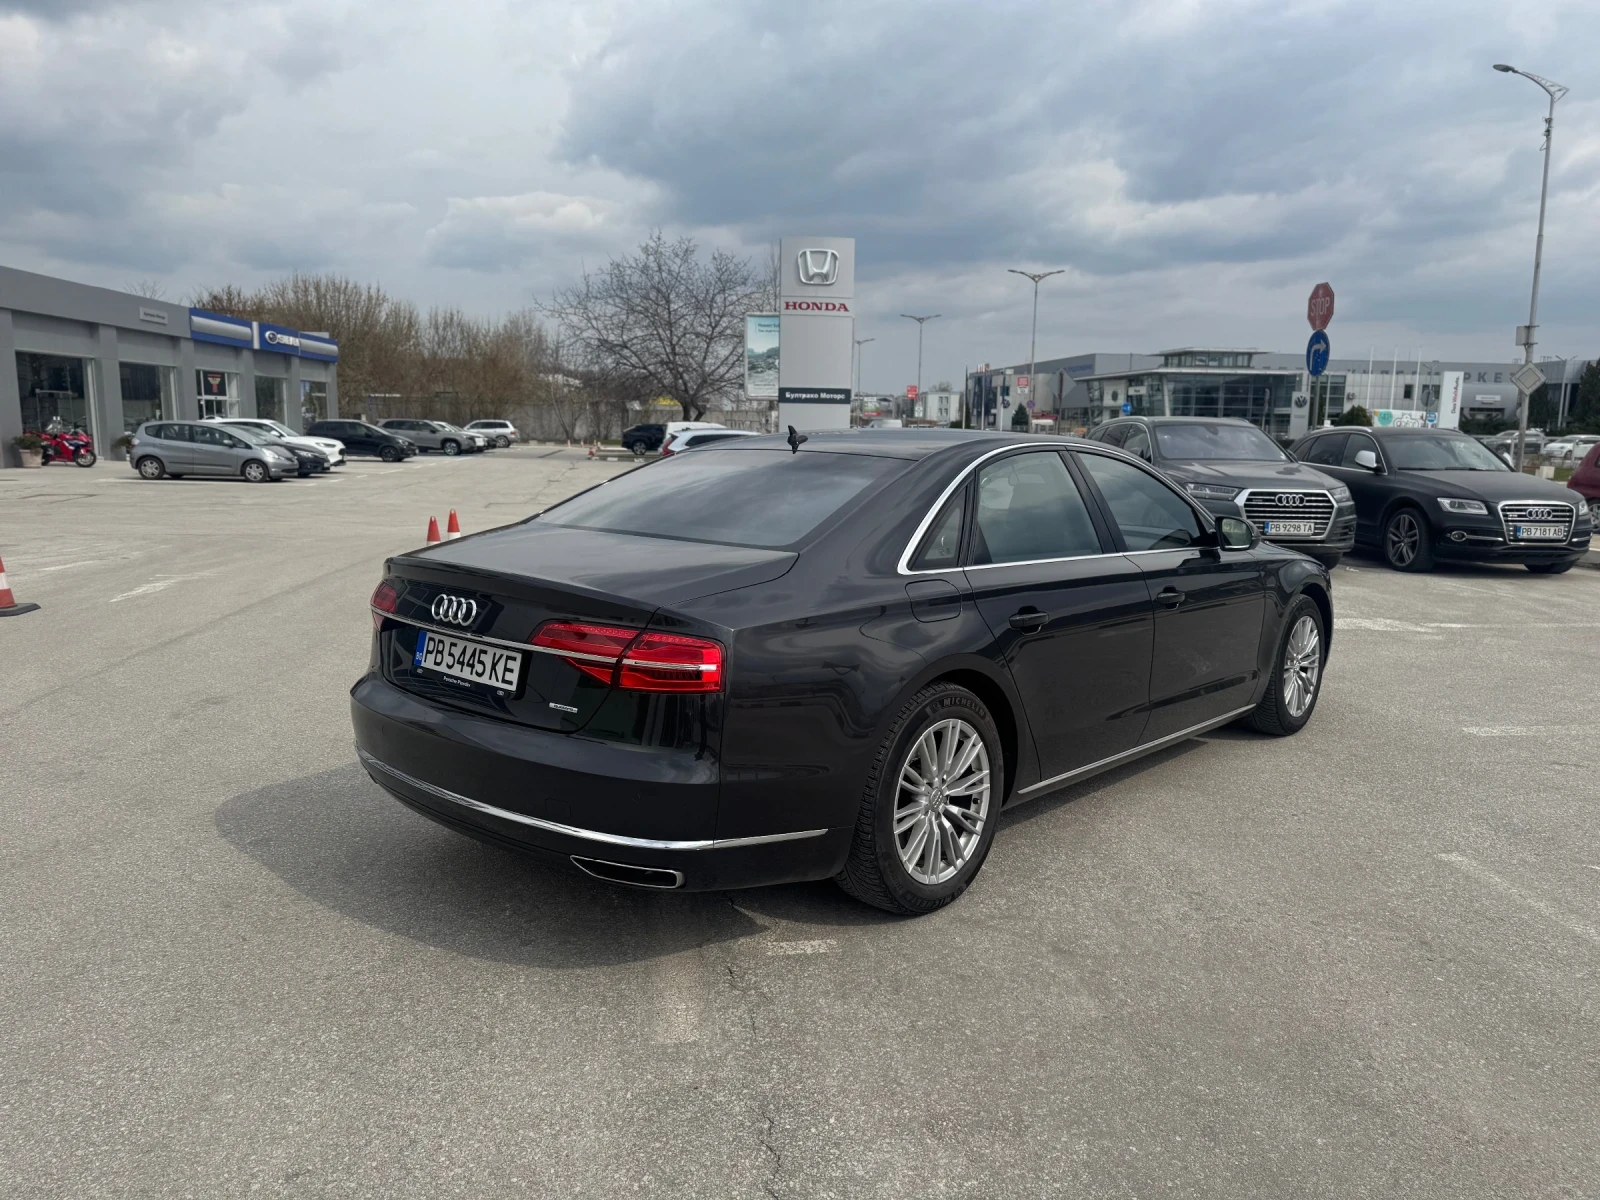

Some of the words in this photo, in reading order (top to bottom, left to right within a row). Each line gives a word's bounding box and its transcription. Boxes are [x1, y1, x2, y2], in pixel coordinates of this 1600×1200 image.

[784, 301, 850, 312] HONDA
[1310, 297, 1330, 316] STOP
[785, 391, 819, 400] Бултрако
[820, 392, 846, 400] Моторс
[1270, 523, 1281, 532] PB
[1282, 523, 1302, 533] 9298
[1303, 524, 1313, 533] TA
[1521, 527, 1532, 536] PB
[1533, 527, 1551, 536] 7181
[1552, 528, 1563, 537] AB
[423, 636, 445, 667] PB
[446, 642, 488, 678] 5445
[489, 652, 517, 686] KE
[943, 696, 985, 717] MICHELIN
